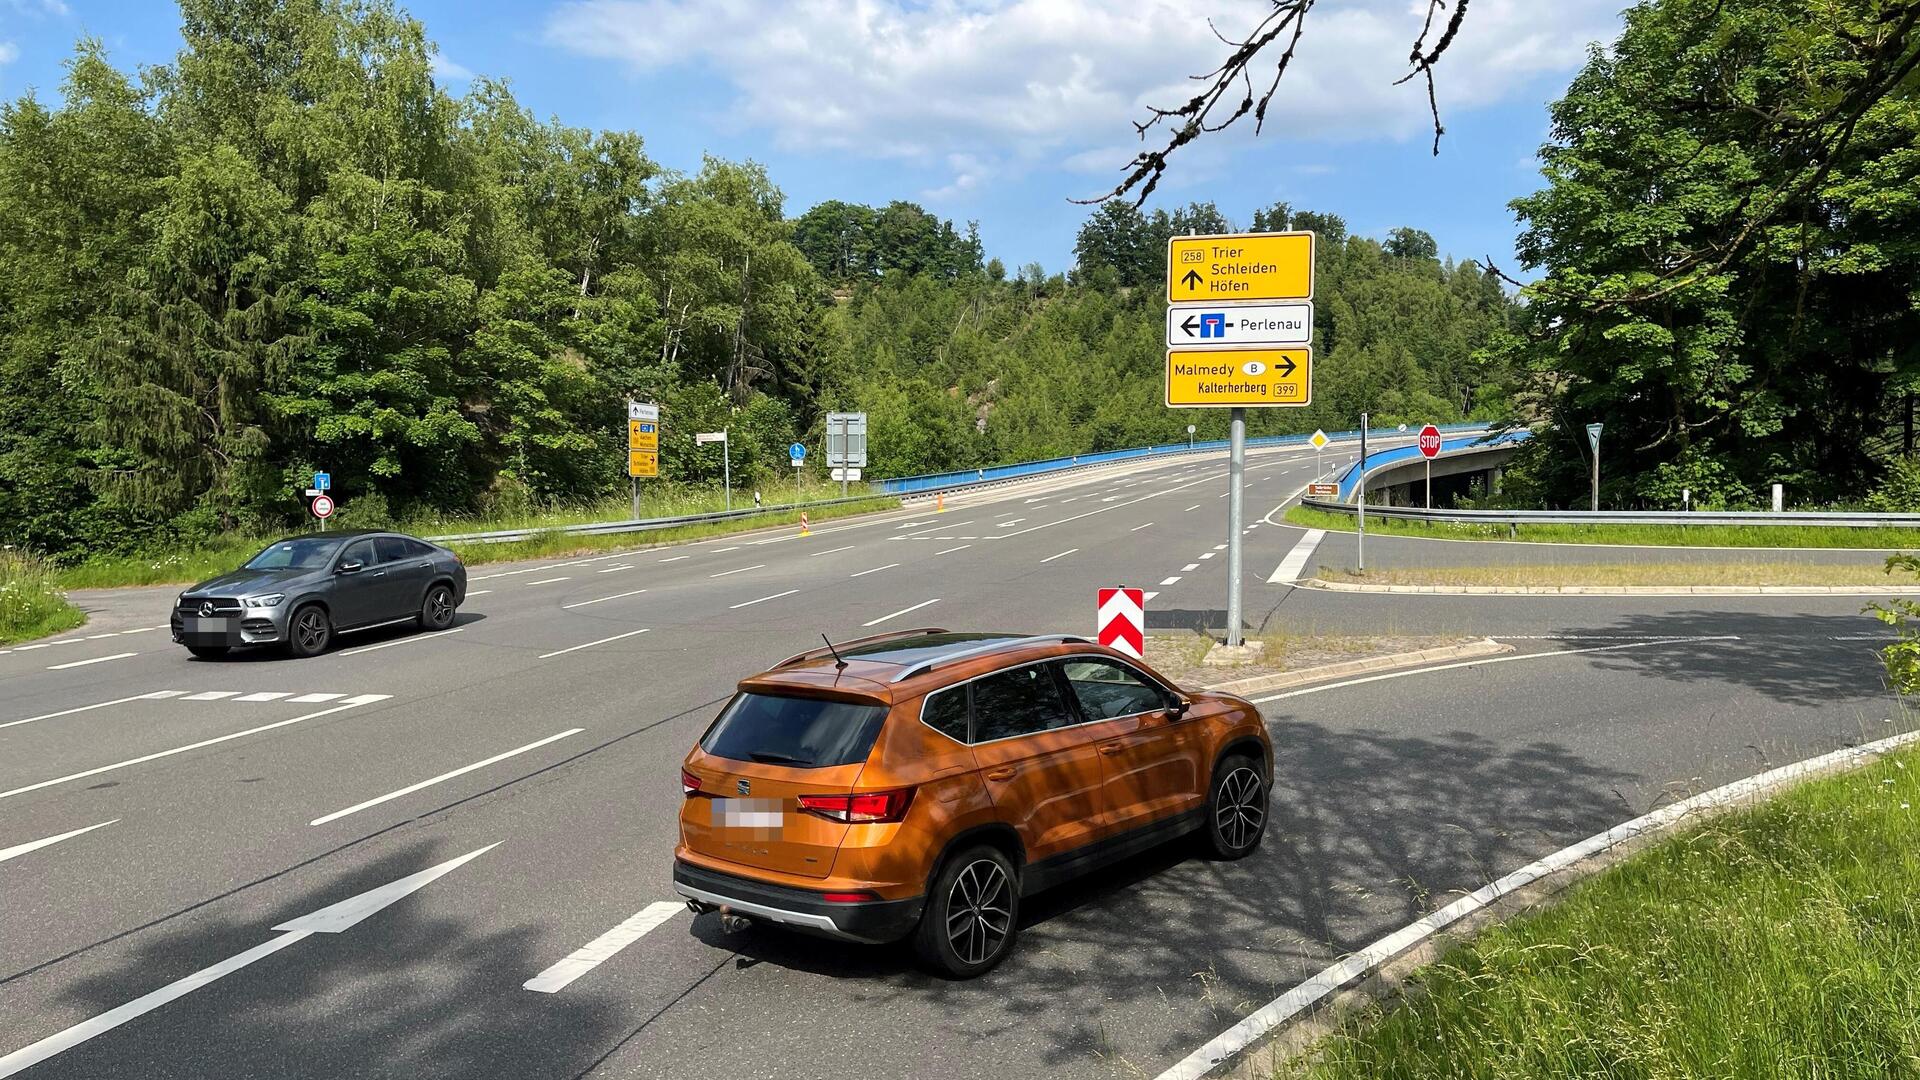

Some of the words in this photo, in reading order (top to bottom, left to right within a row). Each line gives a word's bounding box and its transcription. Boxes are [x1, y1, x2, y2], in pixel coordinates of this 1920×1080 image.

[1184, 251, 1202, 262] 258
[1212, 247, 1244, 258] Trier
[1211, 263, 1277, 275] Schleiden
[1210, 280, 1249, 292] Höfen
[1241, 319, 1302, 331] Perlenau
[1175, 364, 1235, 377] Malmedy
[1250, 364, 1258, 373] B
[1198, 382, 1267, 395] Kalterherberg
[1276, 385, 1295, 395] 399
[1421, 435, 1440, 449] STOP
